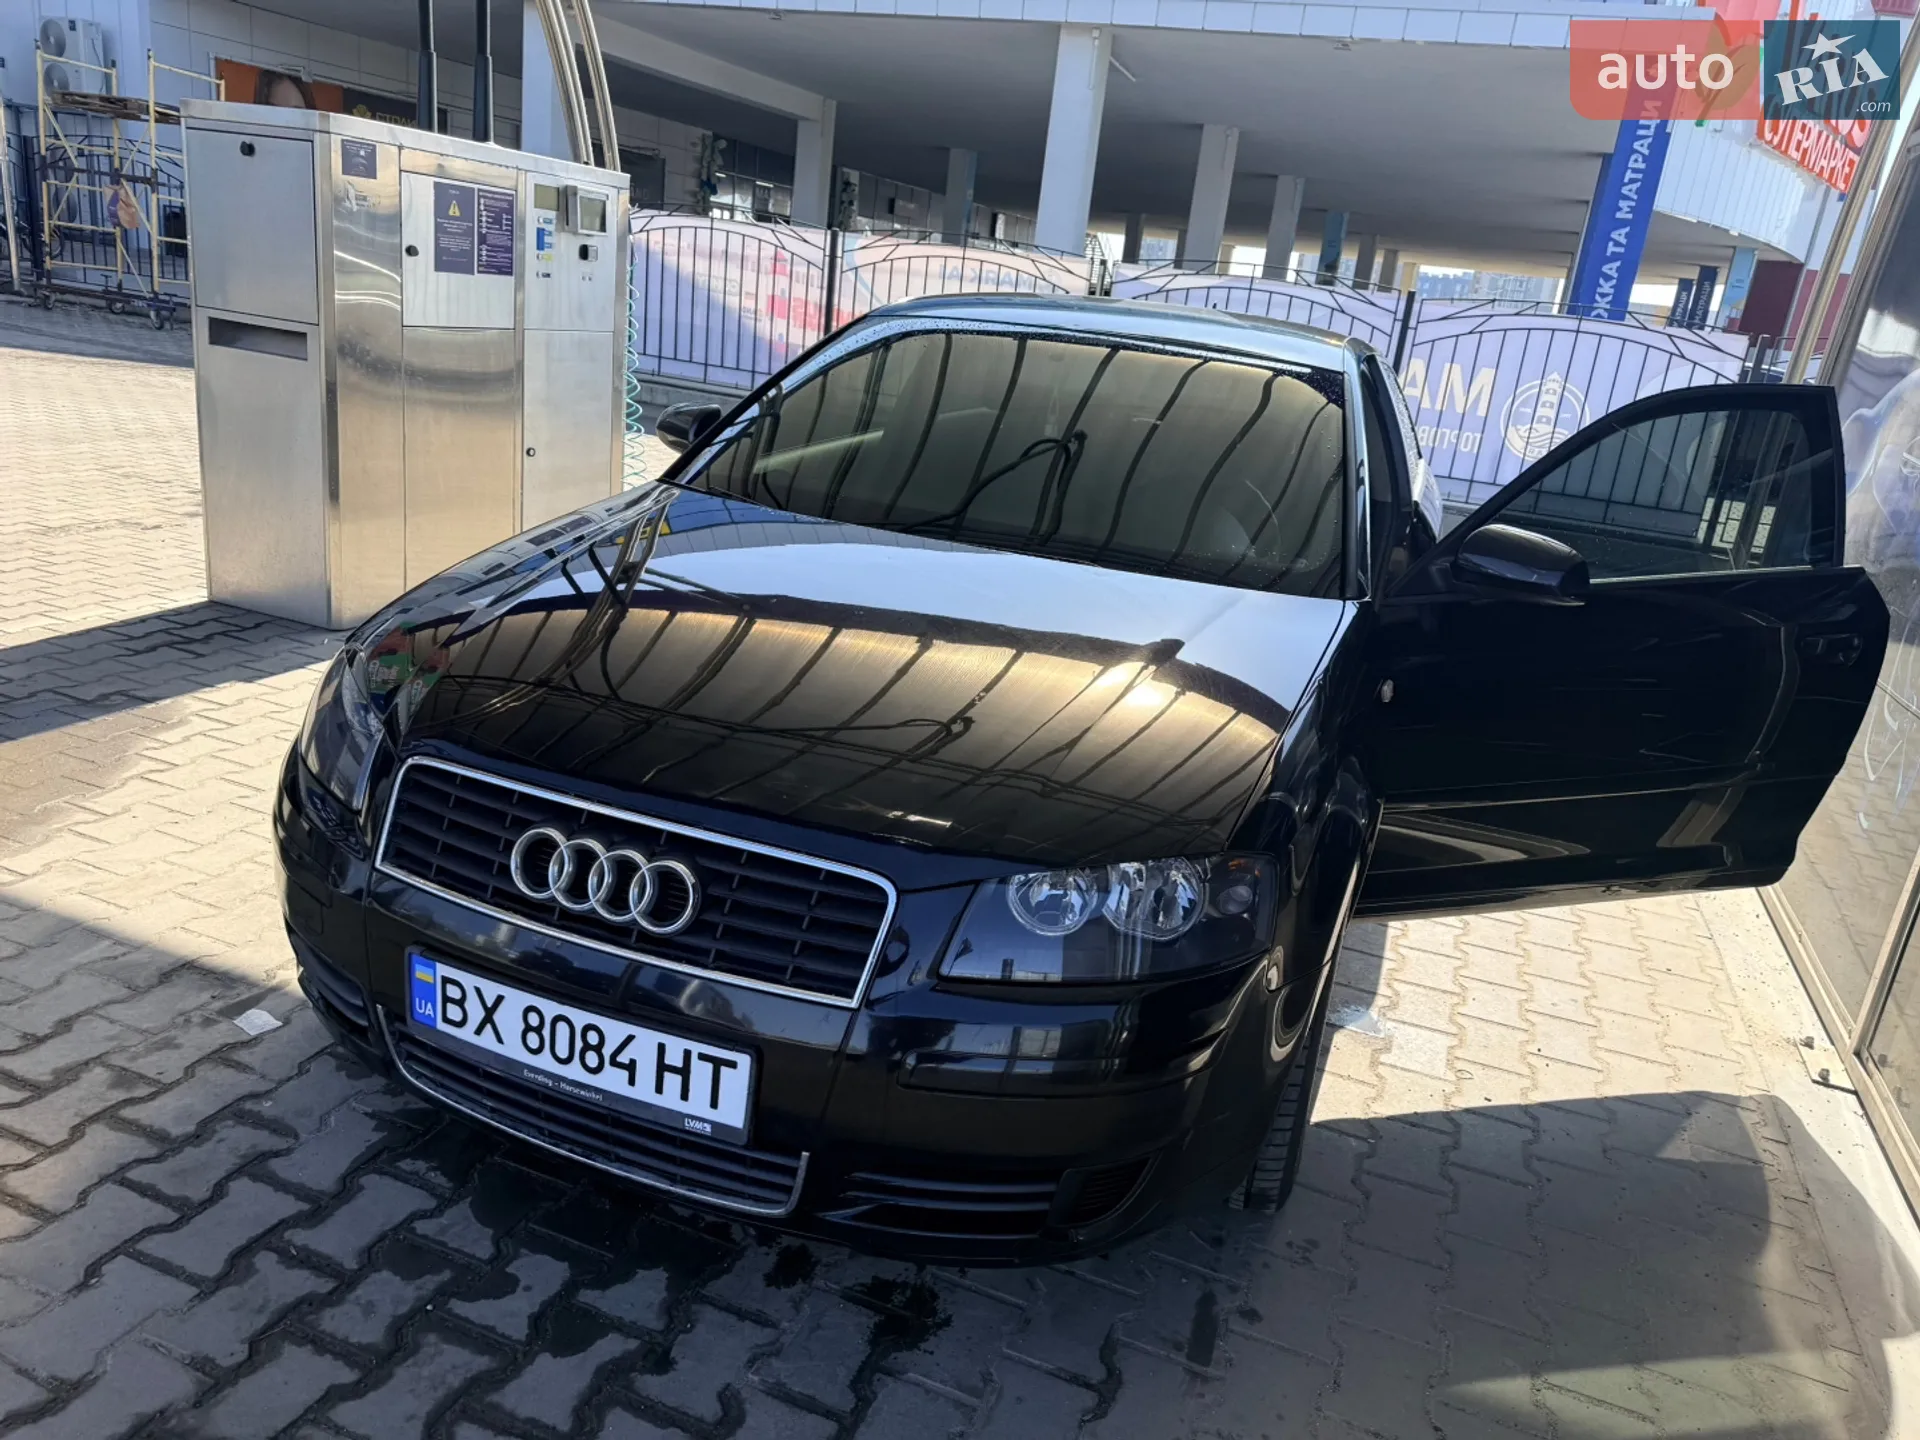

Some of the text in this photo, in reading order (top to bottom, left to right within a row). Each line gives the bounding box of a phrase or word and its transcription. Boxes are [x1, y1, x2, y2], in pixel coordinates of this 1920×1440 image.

[1615, 100, 1663, 220] МАТРАЦИ
[1607, 226, 1630, 257] ТА
[415, 998, 434, 1018] UA
[521, 1005, 637, 1087] 8084
